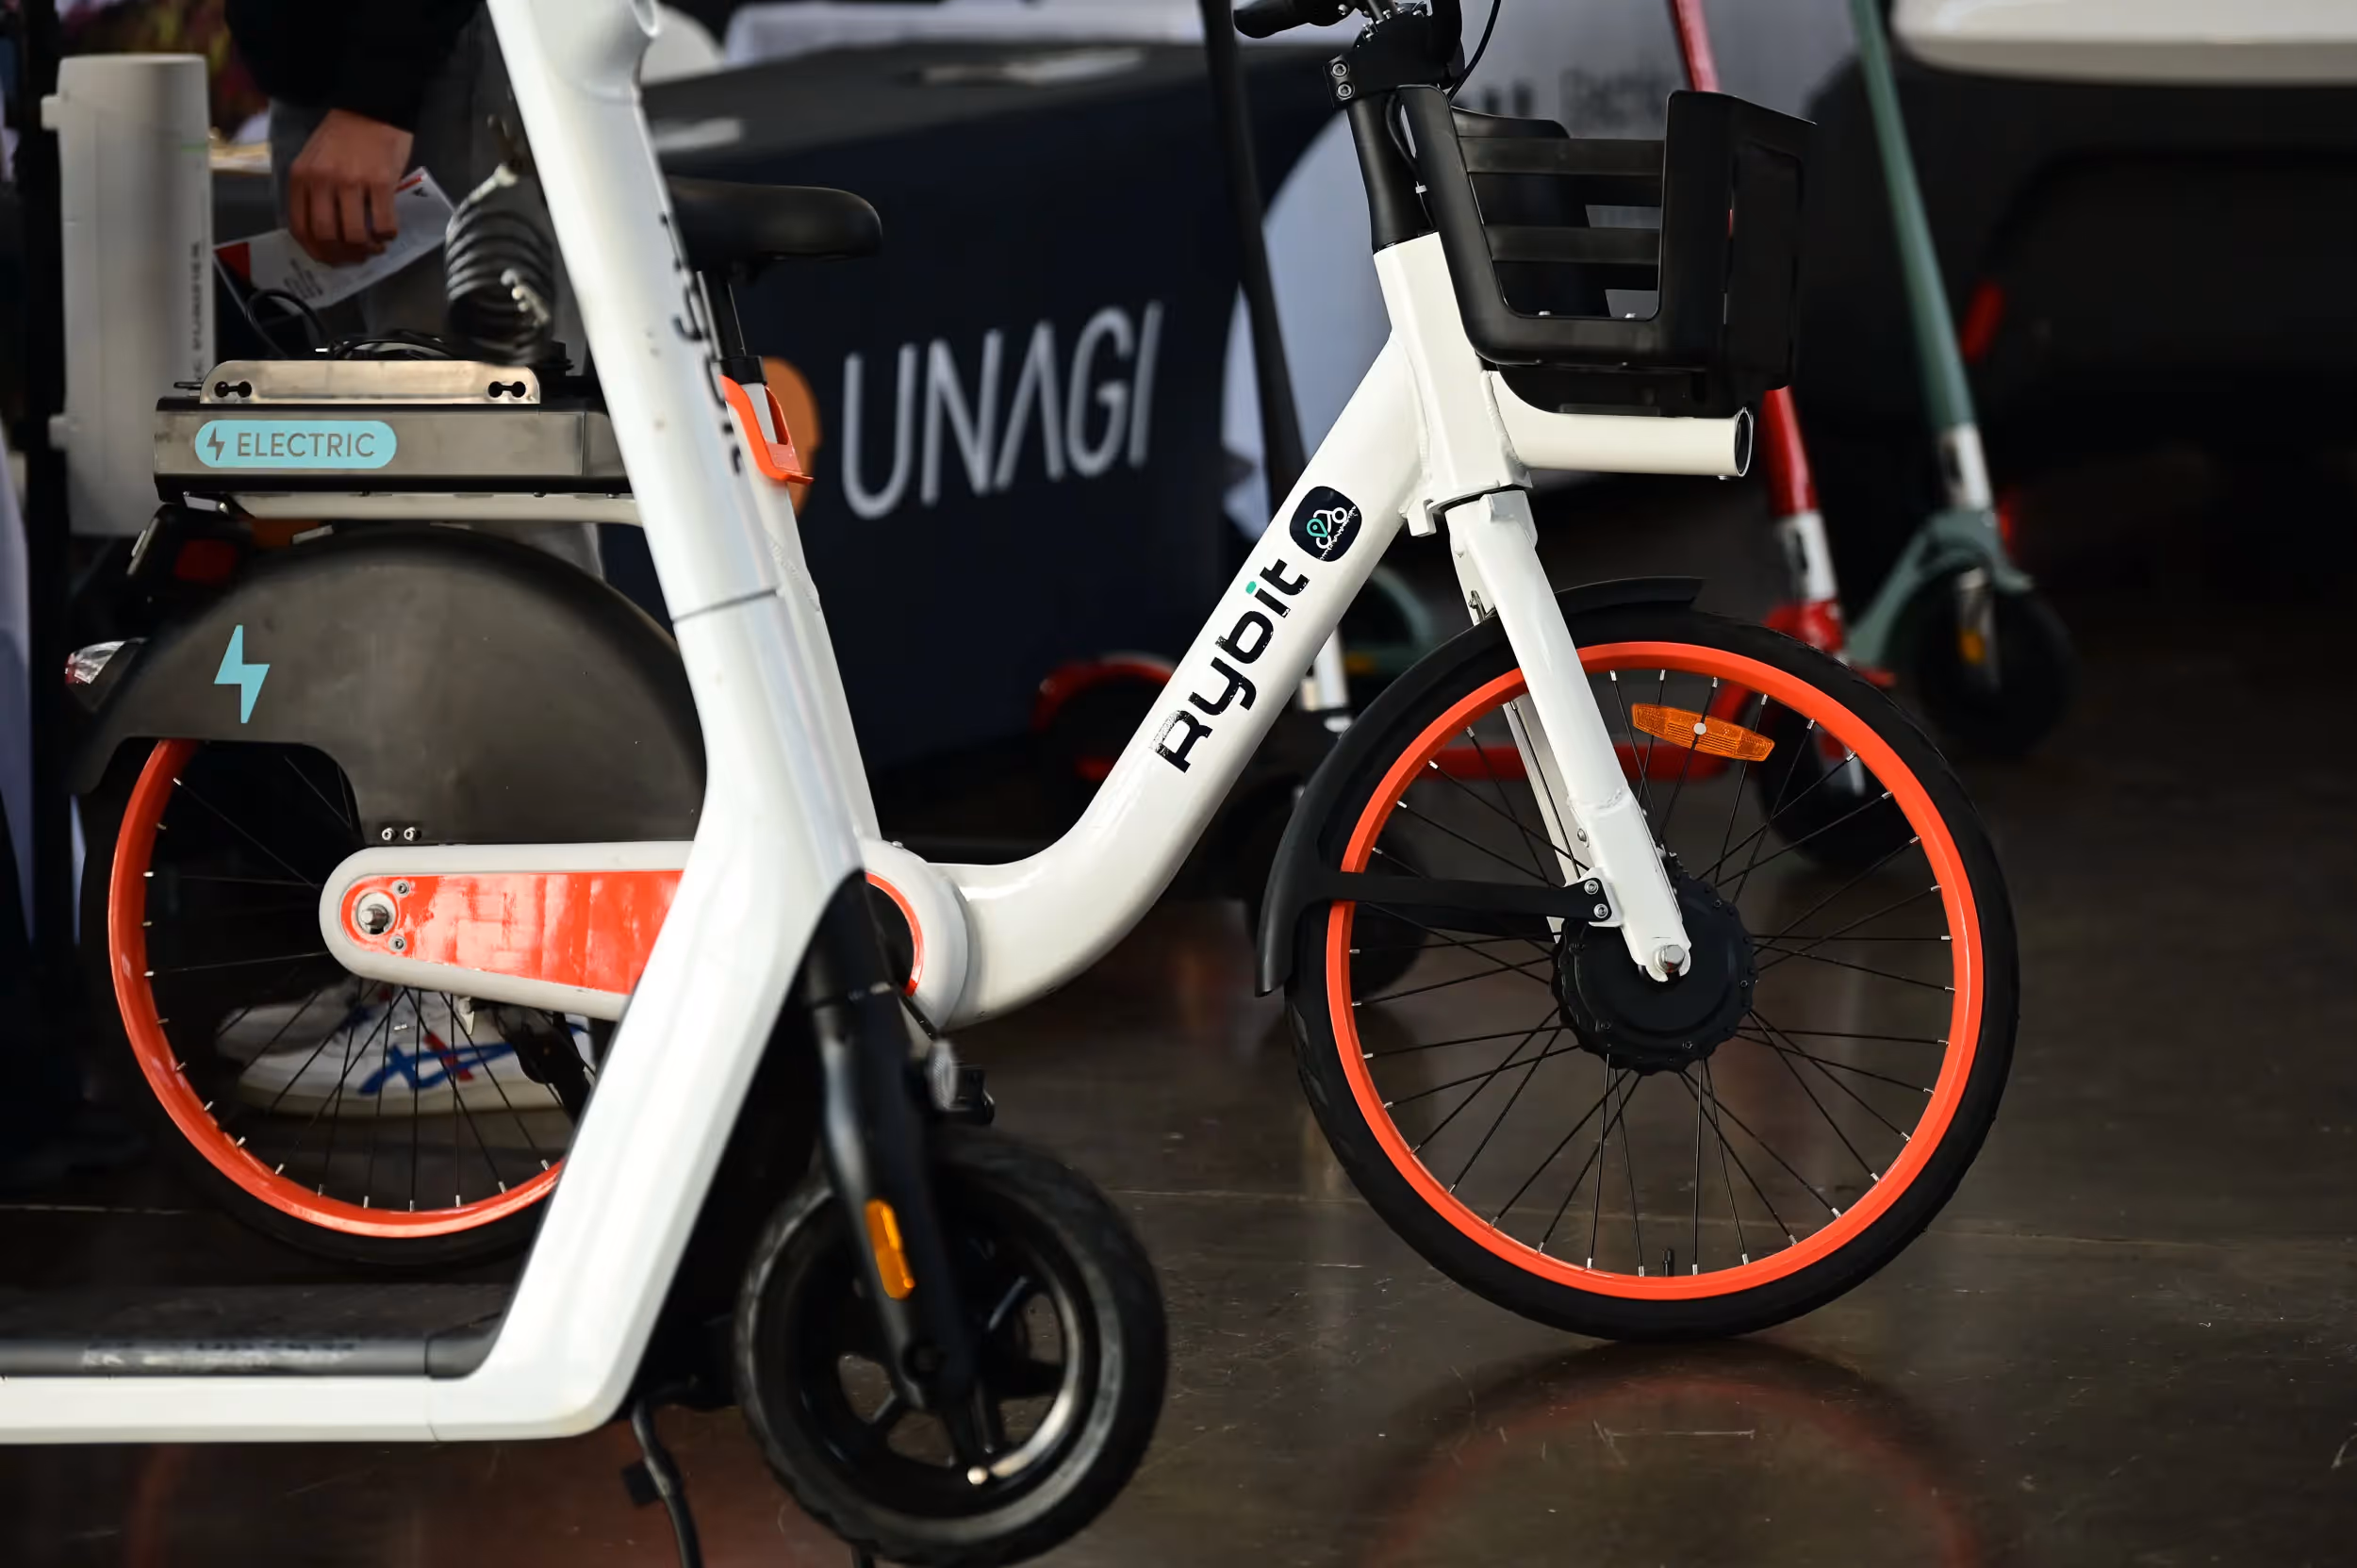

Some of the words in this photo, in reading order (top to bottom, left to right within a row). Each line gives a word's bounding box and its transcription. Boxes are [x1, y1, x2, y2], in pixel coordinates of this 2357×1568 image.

[237, 432, 375, 457] ELECTRIC
[842, 299, 1163, 520] UNAGI
[1149, 558, 1310, 773] Rybit
